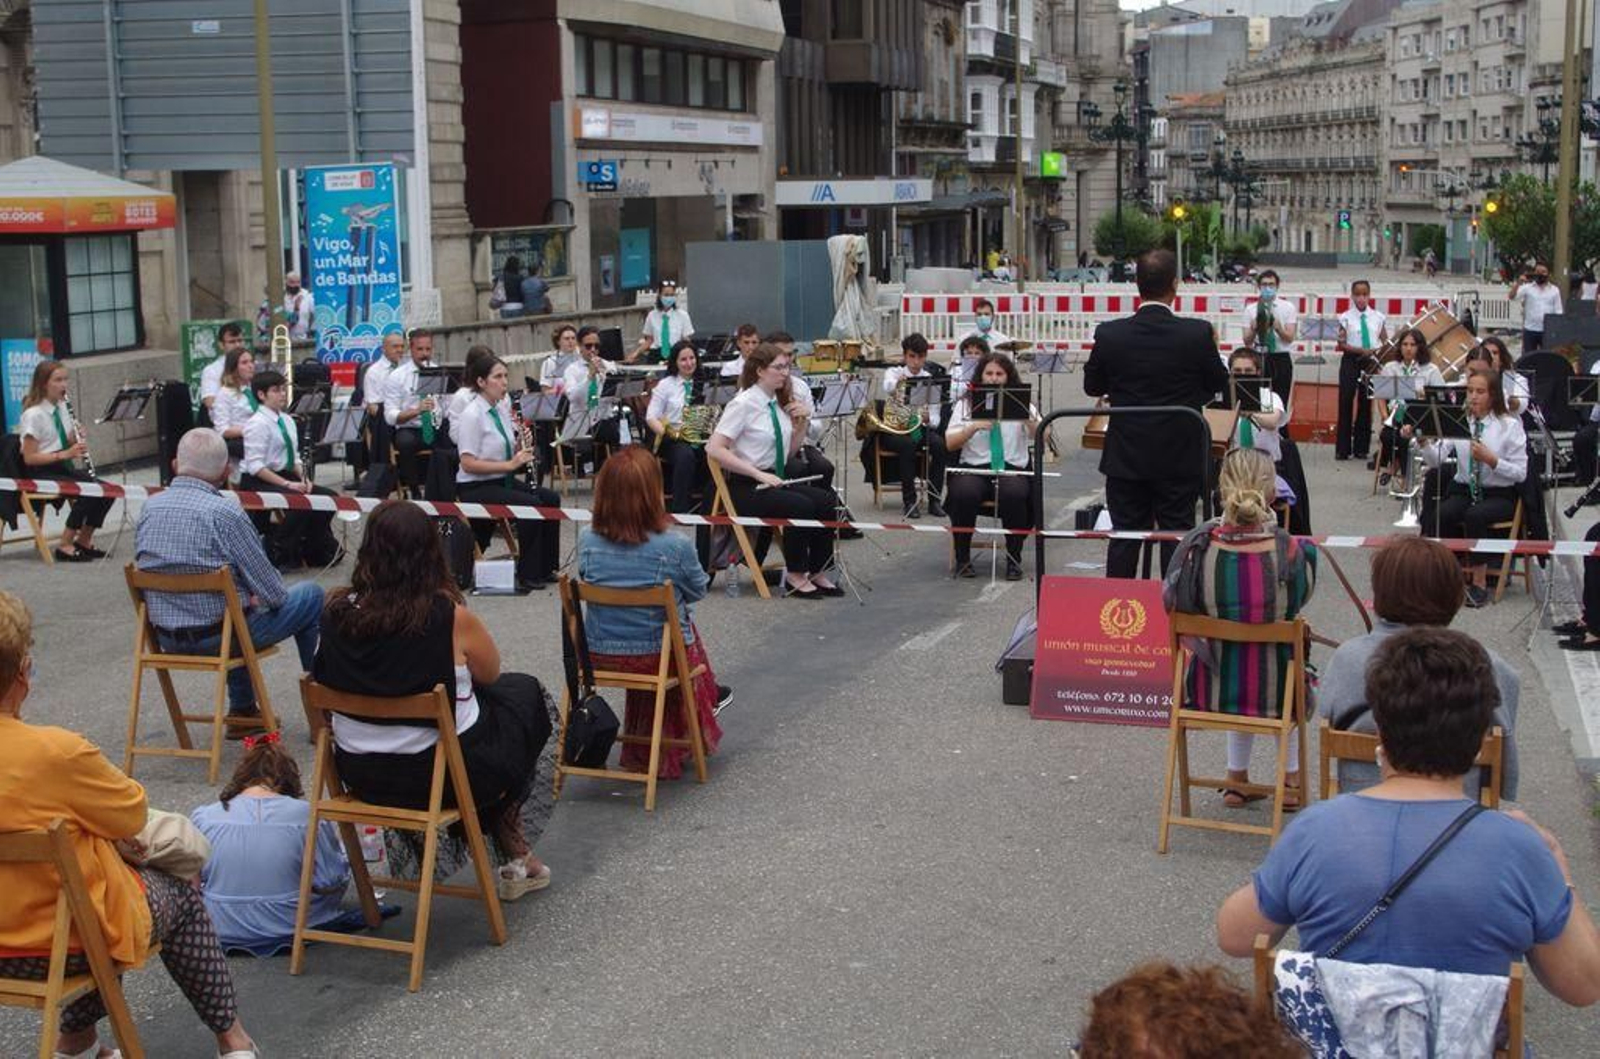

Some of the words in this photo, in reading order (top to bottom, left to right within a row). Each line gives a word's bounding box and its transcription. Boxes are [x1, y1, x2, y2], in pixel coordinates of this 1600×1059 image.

[312, 236, 355, 254] Vigo,
[314, 257, 337, 269] un
[338, 254, 369, 268] Mar
[315, 272, 335, 286] de
[336, 270, 396, 285] Bandas
[1083, 641, 1131, 655] musical
[1134, 645, 1149, 656] de
[1103, 691, 1125, 703] 672
[1129, 693, 1143, 704] 10
[1146, 694, 1158, 705] 61
